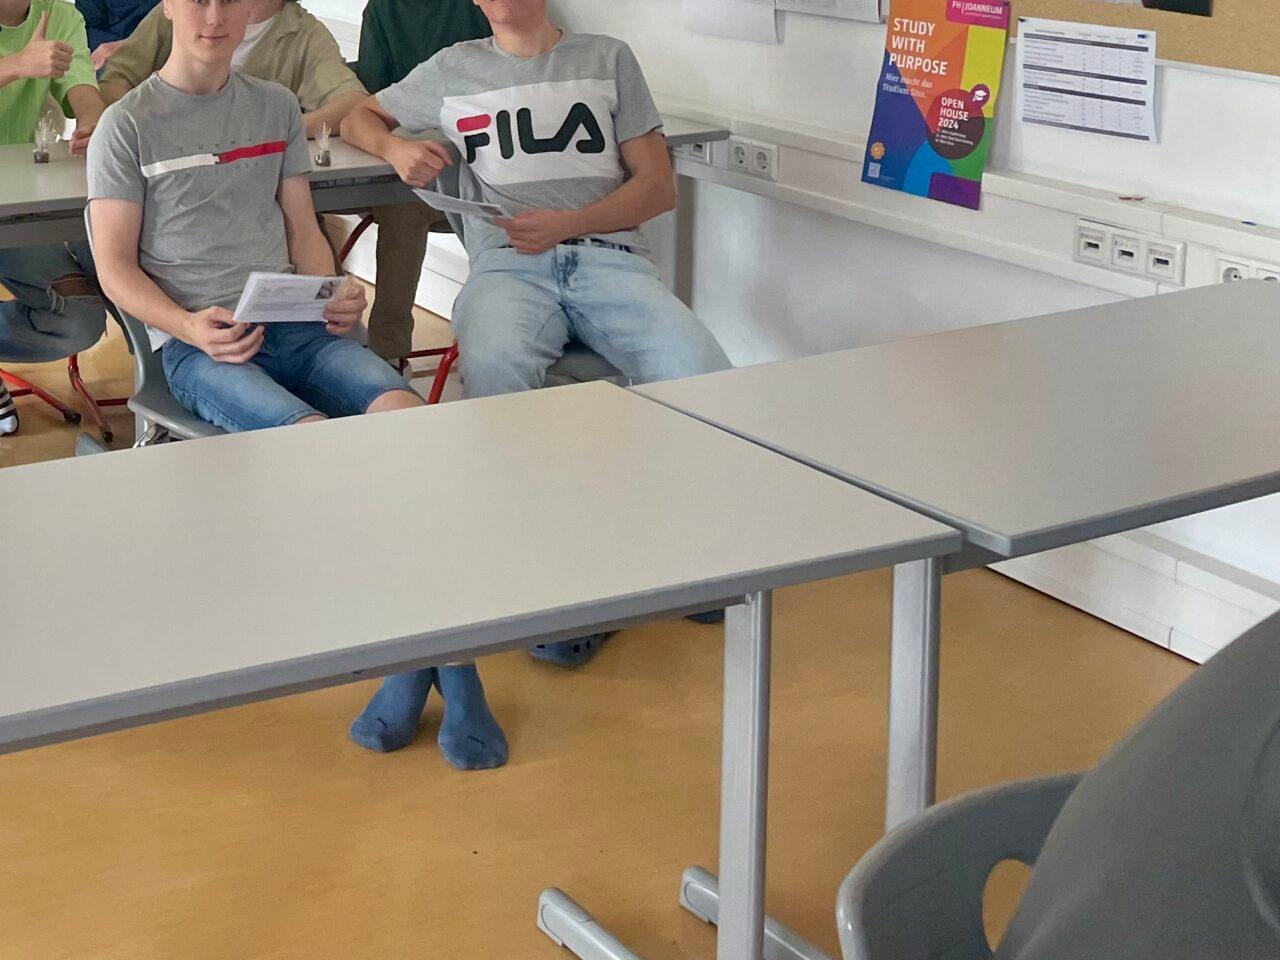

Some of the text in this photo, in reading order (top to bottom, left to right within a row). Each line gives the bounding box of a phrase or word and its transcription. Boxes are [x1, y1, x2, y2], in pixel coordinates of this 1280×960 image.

[893, 18, 935, 36] STUDY
[892, 35, 925, 53] WITH
[889, 52, 948, 75] PURPOSE
[941, 97, 964, 109] OPEN
[940, 107, 969, 121] HOUSE
[938, 117, 959, 130] 2024
[456, 102, 605, 164] FILA
